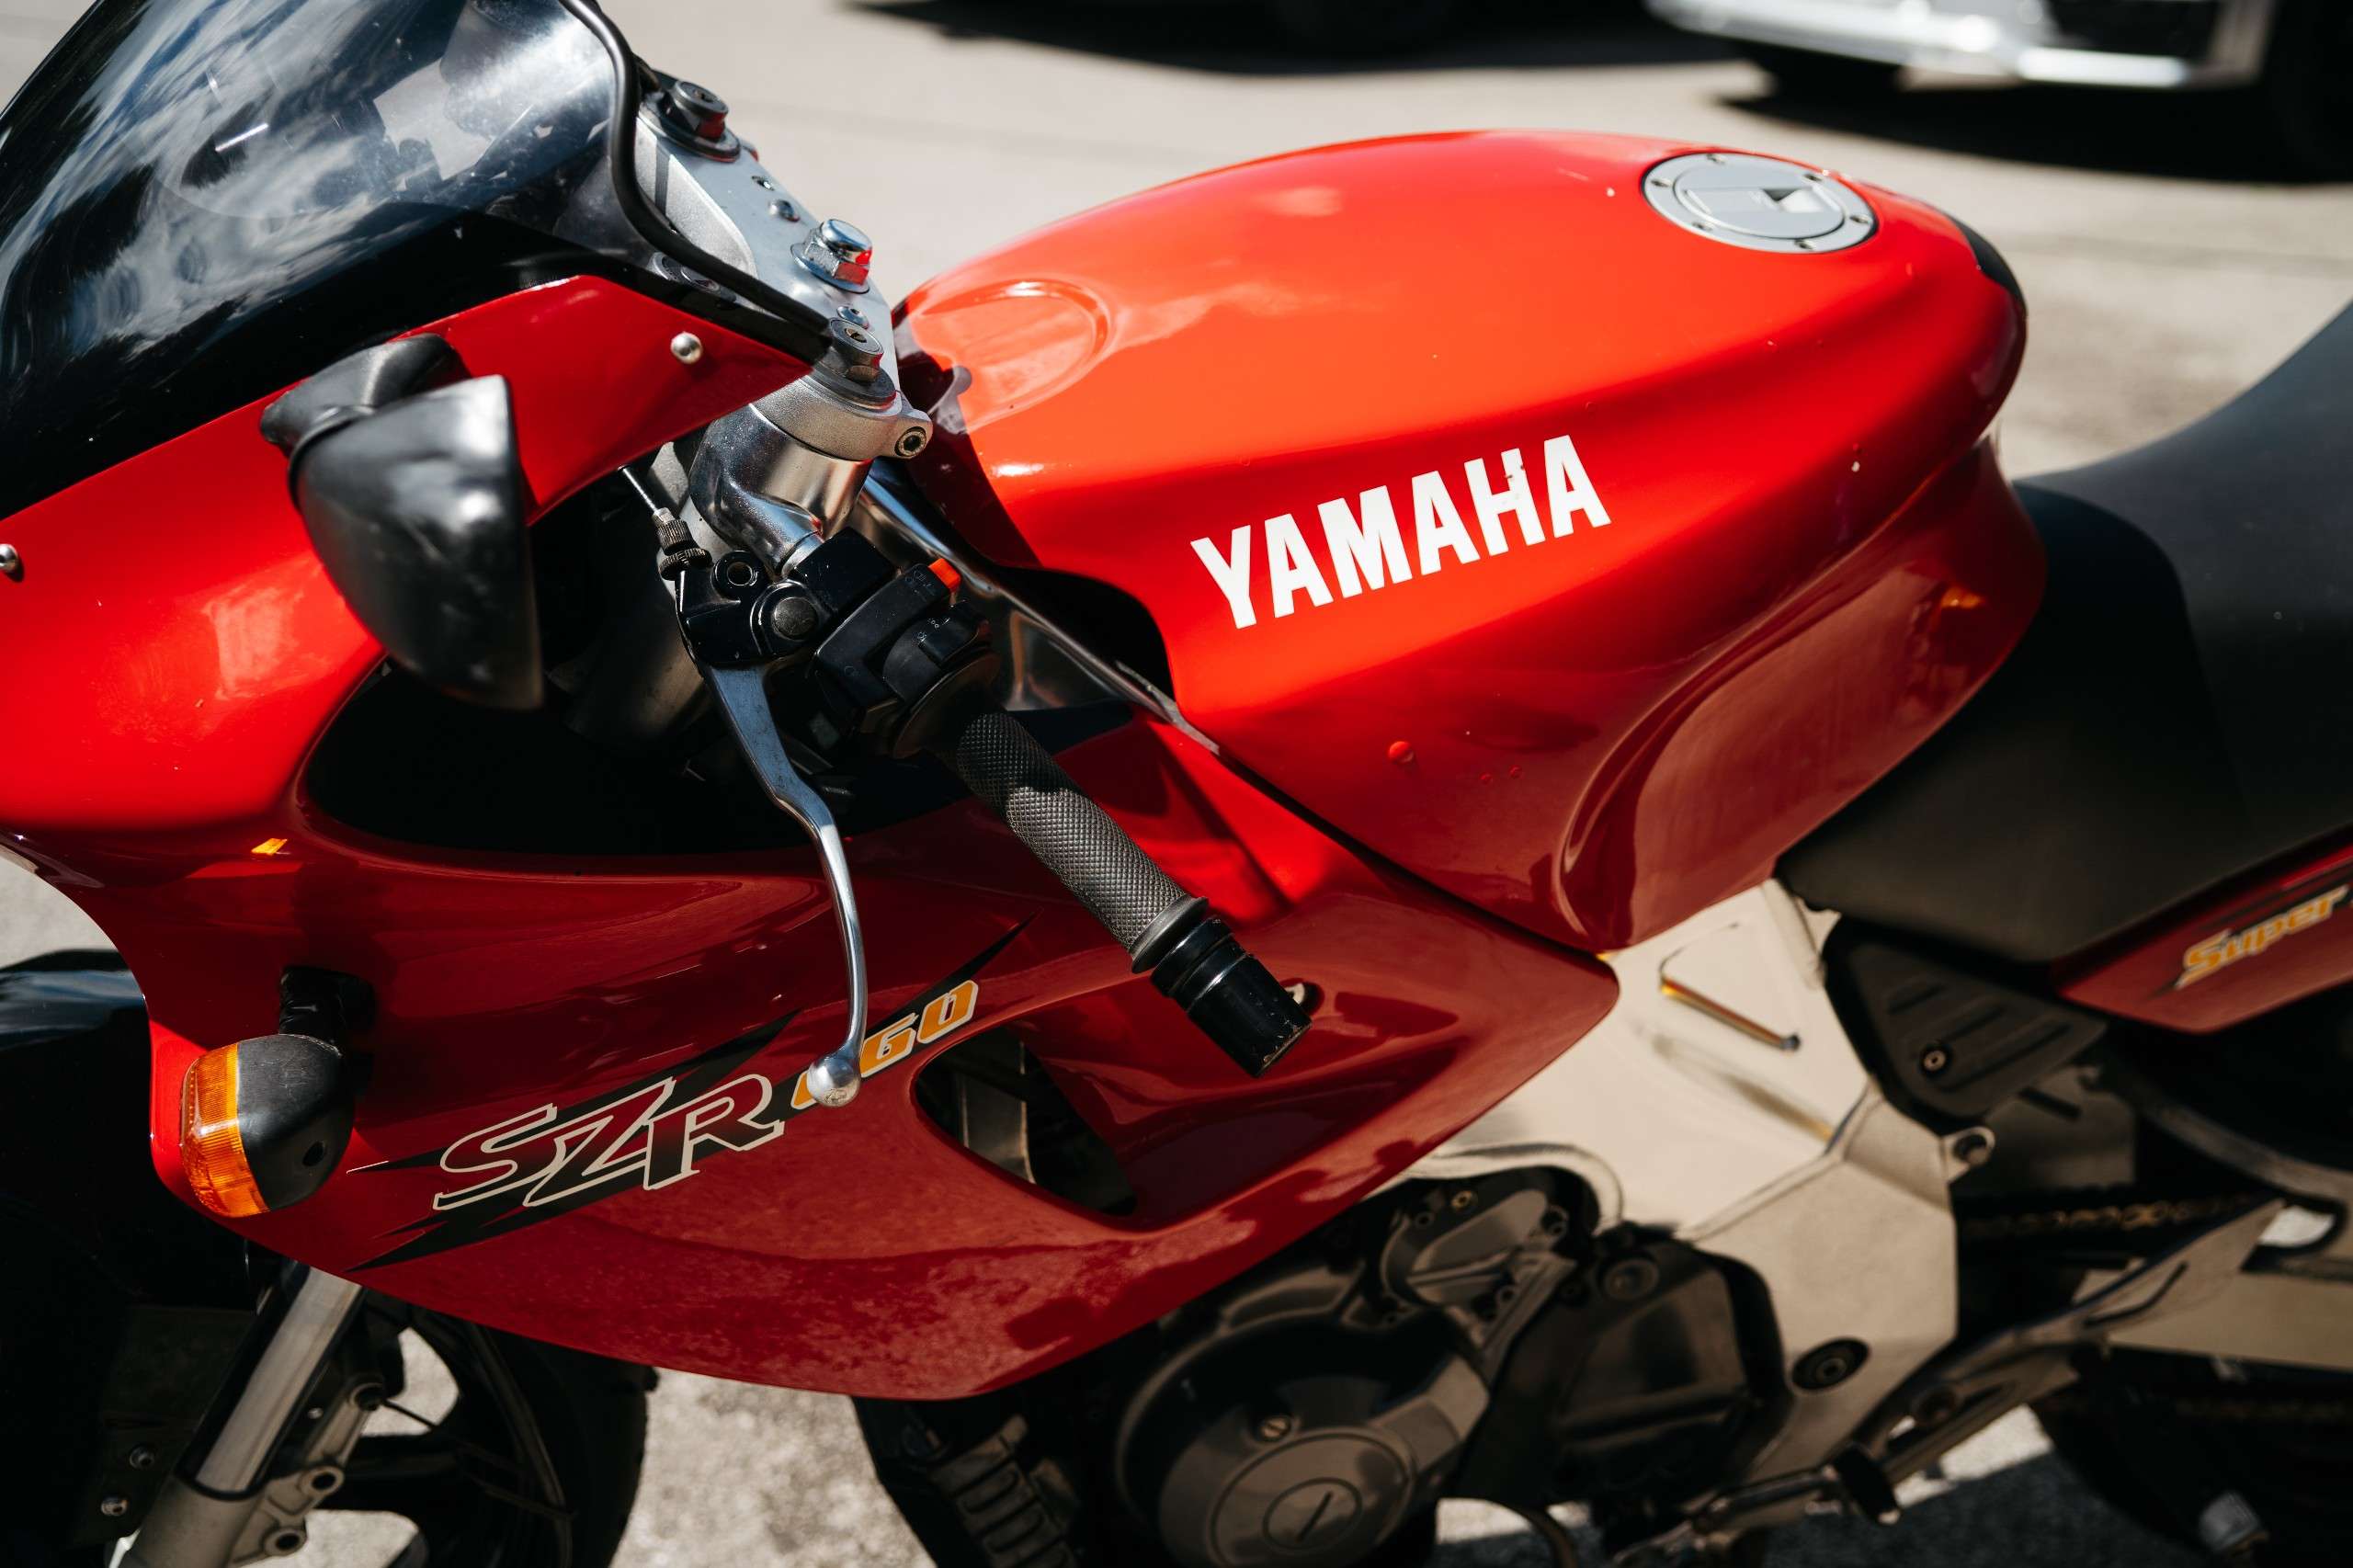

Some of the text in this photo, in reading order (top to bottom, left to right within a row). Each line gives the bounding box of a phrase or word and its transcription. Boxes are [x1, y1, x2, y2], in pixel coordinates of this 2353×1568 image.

[1190, 435, 1611, 629] YAMAHA
[2175, 884, 2349, 990] Super
[432, 1074, 784, 1210] SZR
